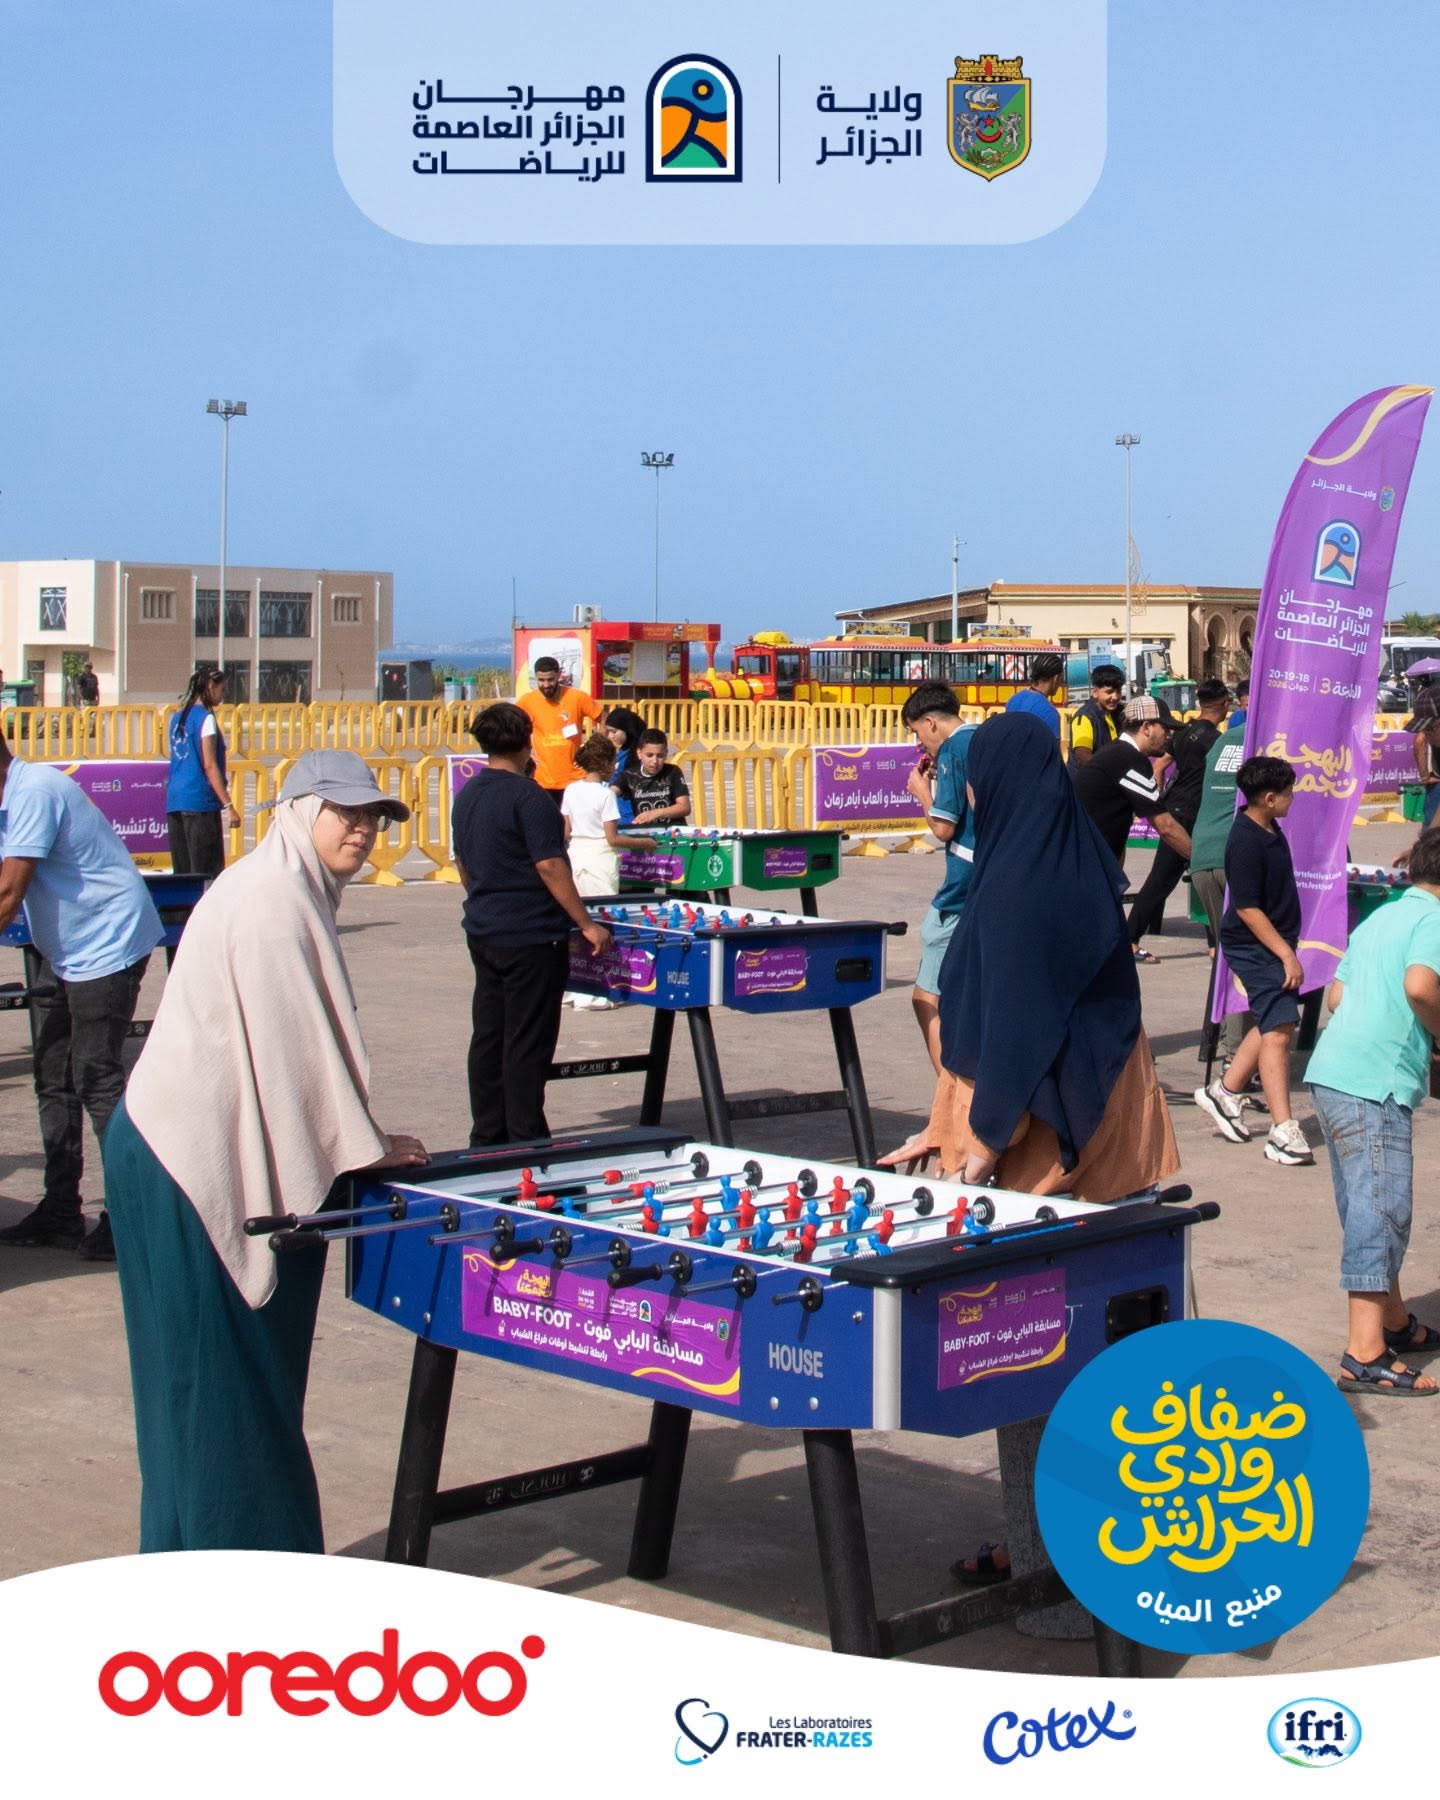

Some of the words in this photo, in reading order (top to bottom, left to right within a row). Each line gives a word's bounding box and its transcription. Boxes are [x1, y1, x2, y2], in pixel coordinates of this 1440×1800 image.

[1311, 478, 1345, 492] الجزائر
[1346, 486, 1377, 501] ولاية
[1280, 589, 1373, 620] مهرجان
[1277, 607, 1337, 629] العاصمة
[1339, 616, 1370, 637] الجزائر
[1275, 627, 1367, 656] للرياضات
[1267, 680, 1288, 689] 2026
[1269, 669, 1310, 683] 20-19-18
[1288, 682, 1309, 693] جوان
[1319, 677, 1331, 694] 3
[667, 971, 690, 985] HOUSE
[493, 1296, 573, 1330] BABY-FOOT
[511, 1328, 533, 1340] الشباب
[584, 1319, 612, 1344] فوت
[1013, 1321, 1033, 1345] البابي
[1034, 1319, 1061, 1333] مسابقة
[533, 1331, 548, 1344] فراغ
[548, 1337, 568, 1351] أوقات
[613, 1329, 650, 1355] البابي
[943, 1332, 991, 1353] BABY-FOOT
[996, 1327, 1013, 1344] فوت
[568, 1340, 590, 1355] تنشيط
[590, 1346, 608, 1362] رابطة
[653, 1335, 704, 1366] مسابقة
[769, 1341, 824, 1378] HOUSE
